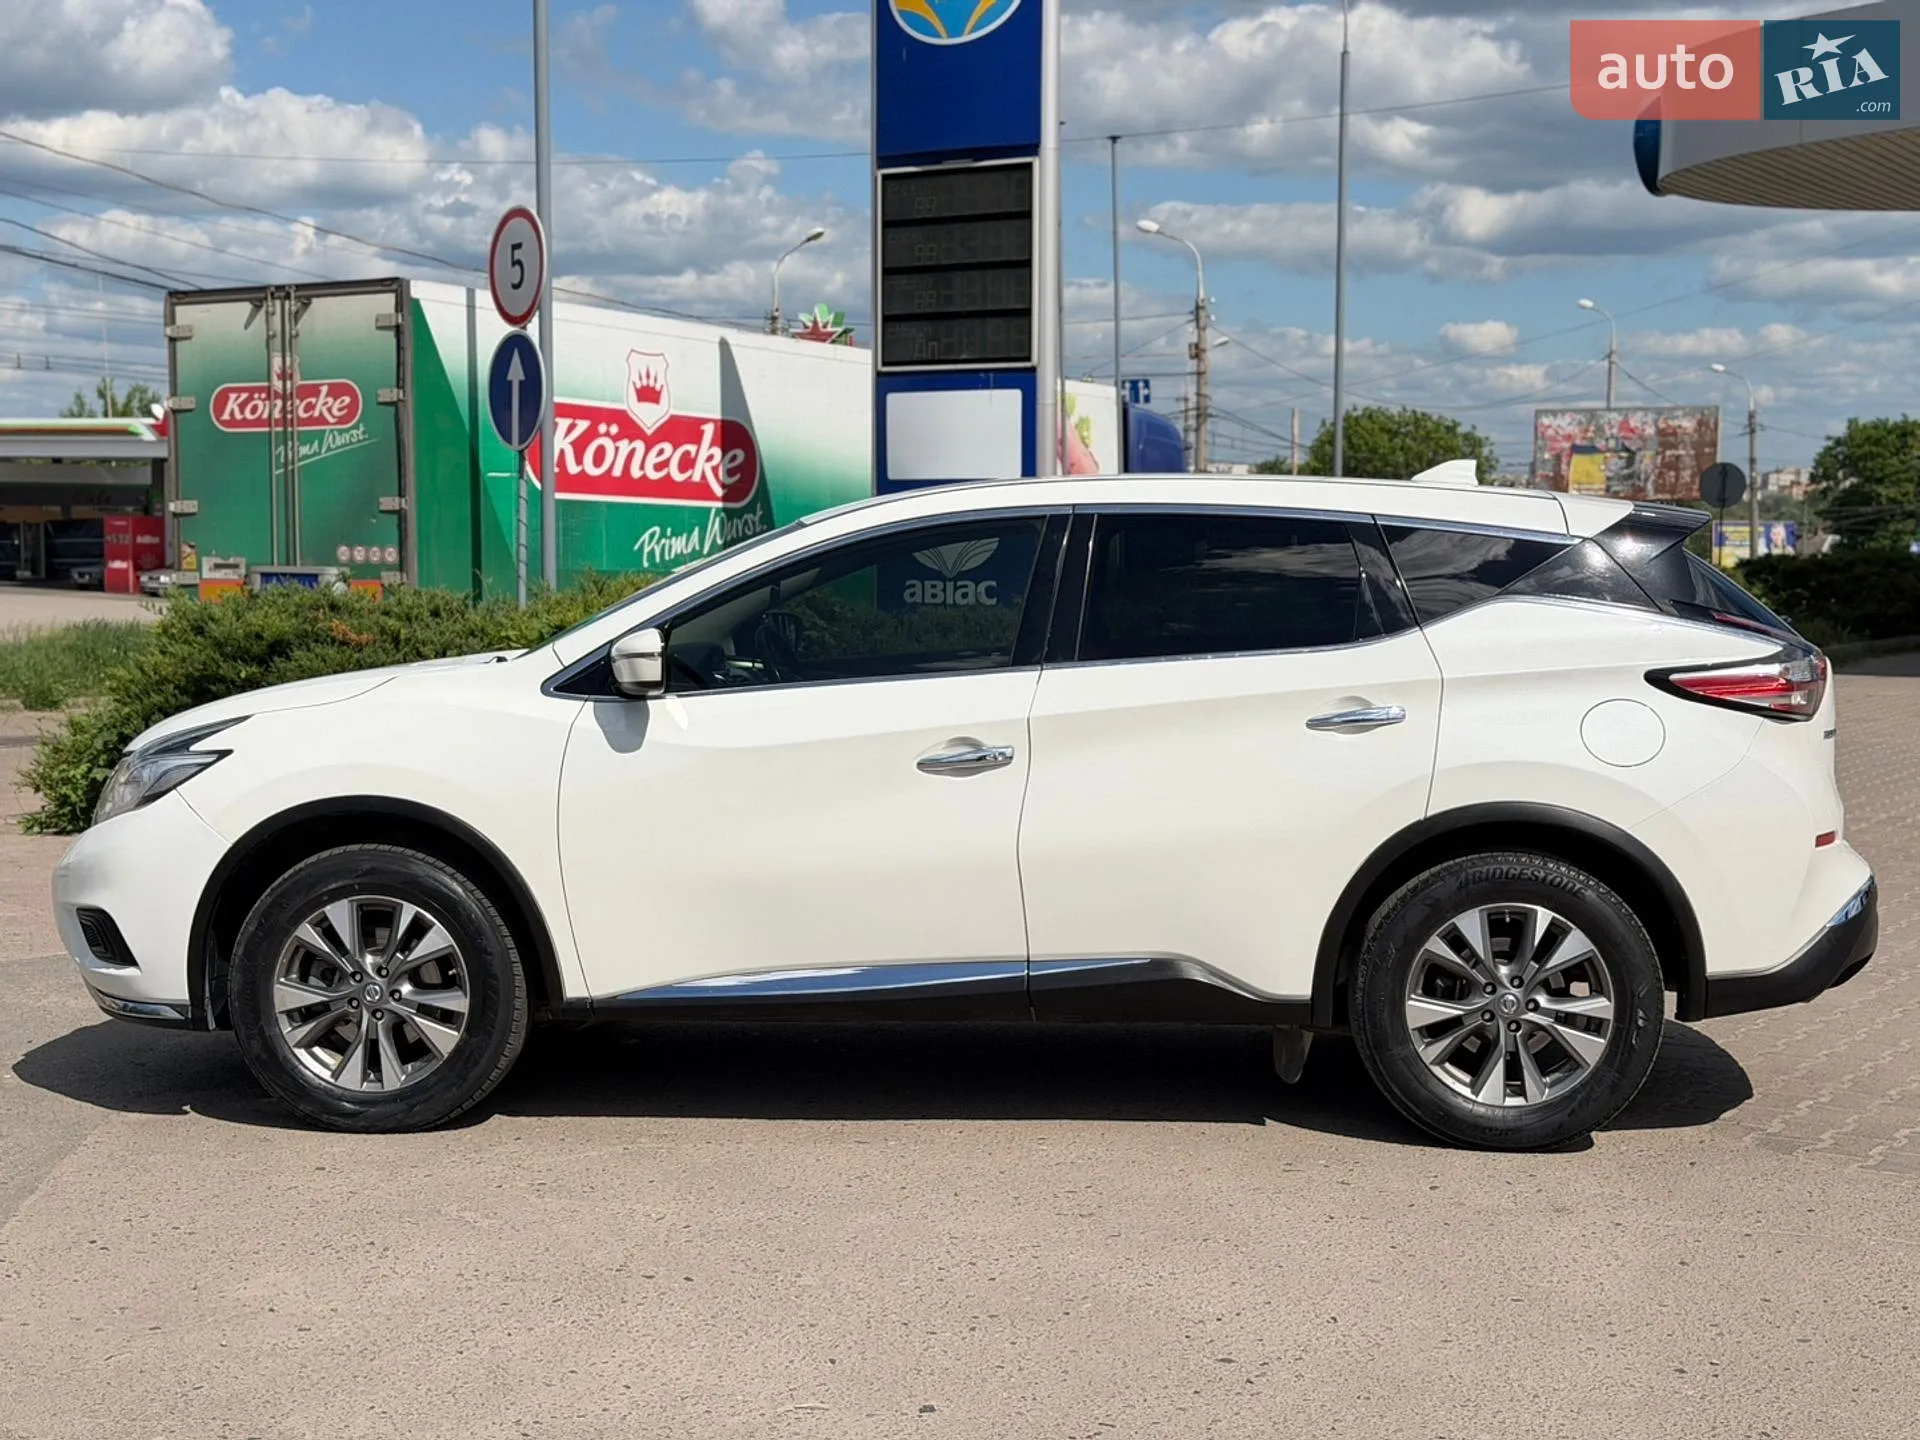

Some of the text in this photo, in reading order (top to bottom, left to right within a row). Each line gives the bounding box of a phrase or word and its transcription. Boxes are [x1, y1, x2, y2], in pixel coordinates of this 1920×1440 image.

[511, 242, 525, 290] 5
[554, 417, 746, 498] Könecke
[634, 525, 700, 568] Prima
[1457, 866, 1589, 899] BRIDGESTONE
